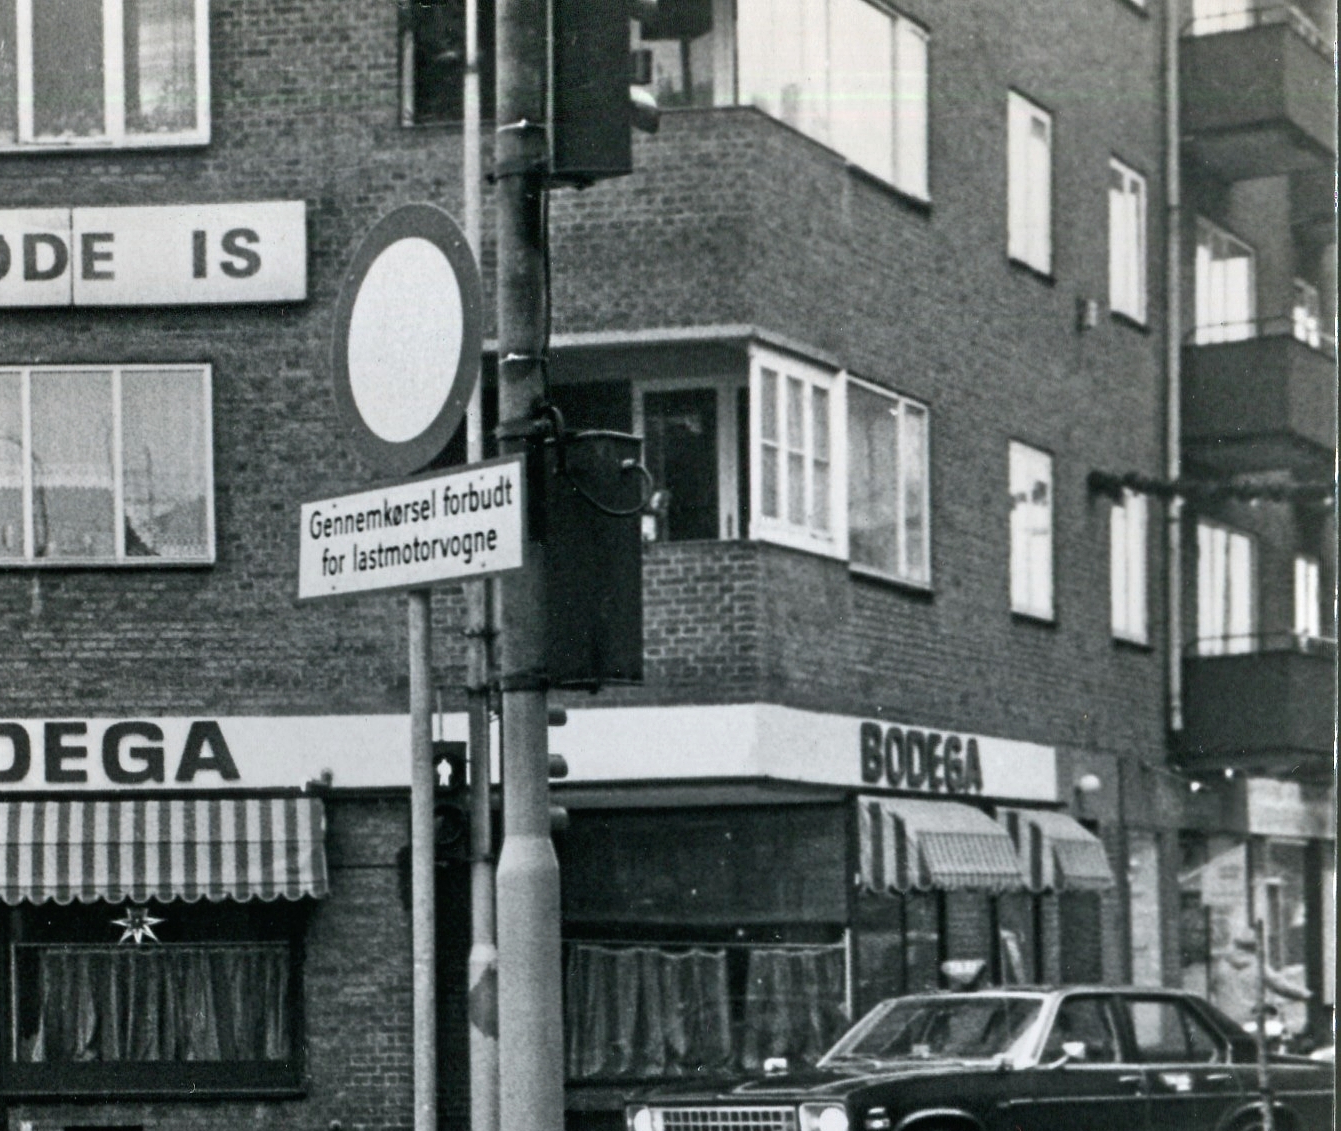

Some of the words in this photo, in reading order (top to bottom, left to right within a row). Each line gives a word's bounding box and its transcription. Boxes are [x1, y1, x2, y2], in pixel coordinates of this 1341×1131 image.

[192, 227, 262, 279] IS
[309, 489, 437, 540] Gennemkørsel
[443, 475, 513, 517] forbudt
[322, 547, 346, 576] for
[353, 528, 498, 572] lastmotorvogne
[860, 721, 984, 795] BODEGA
